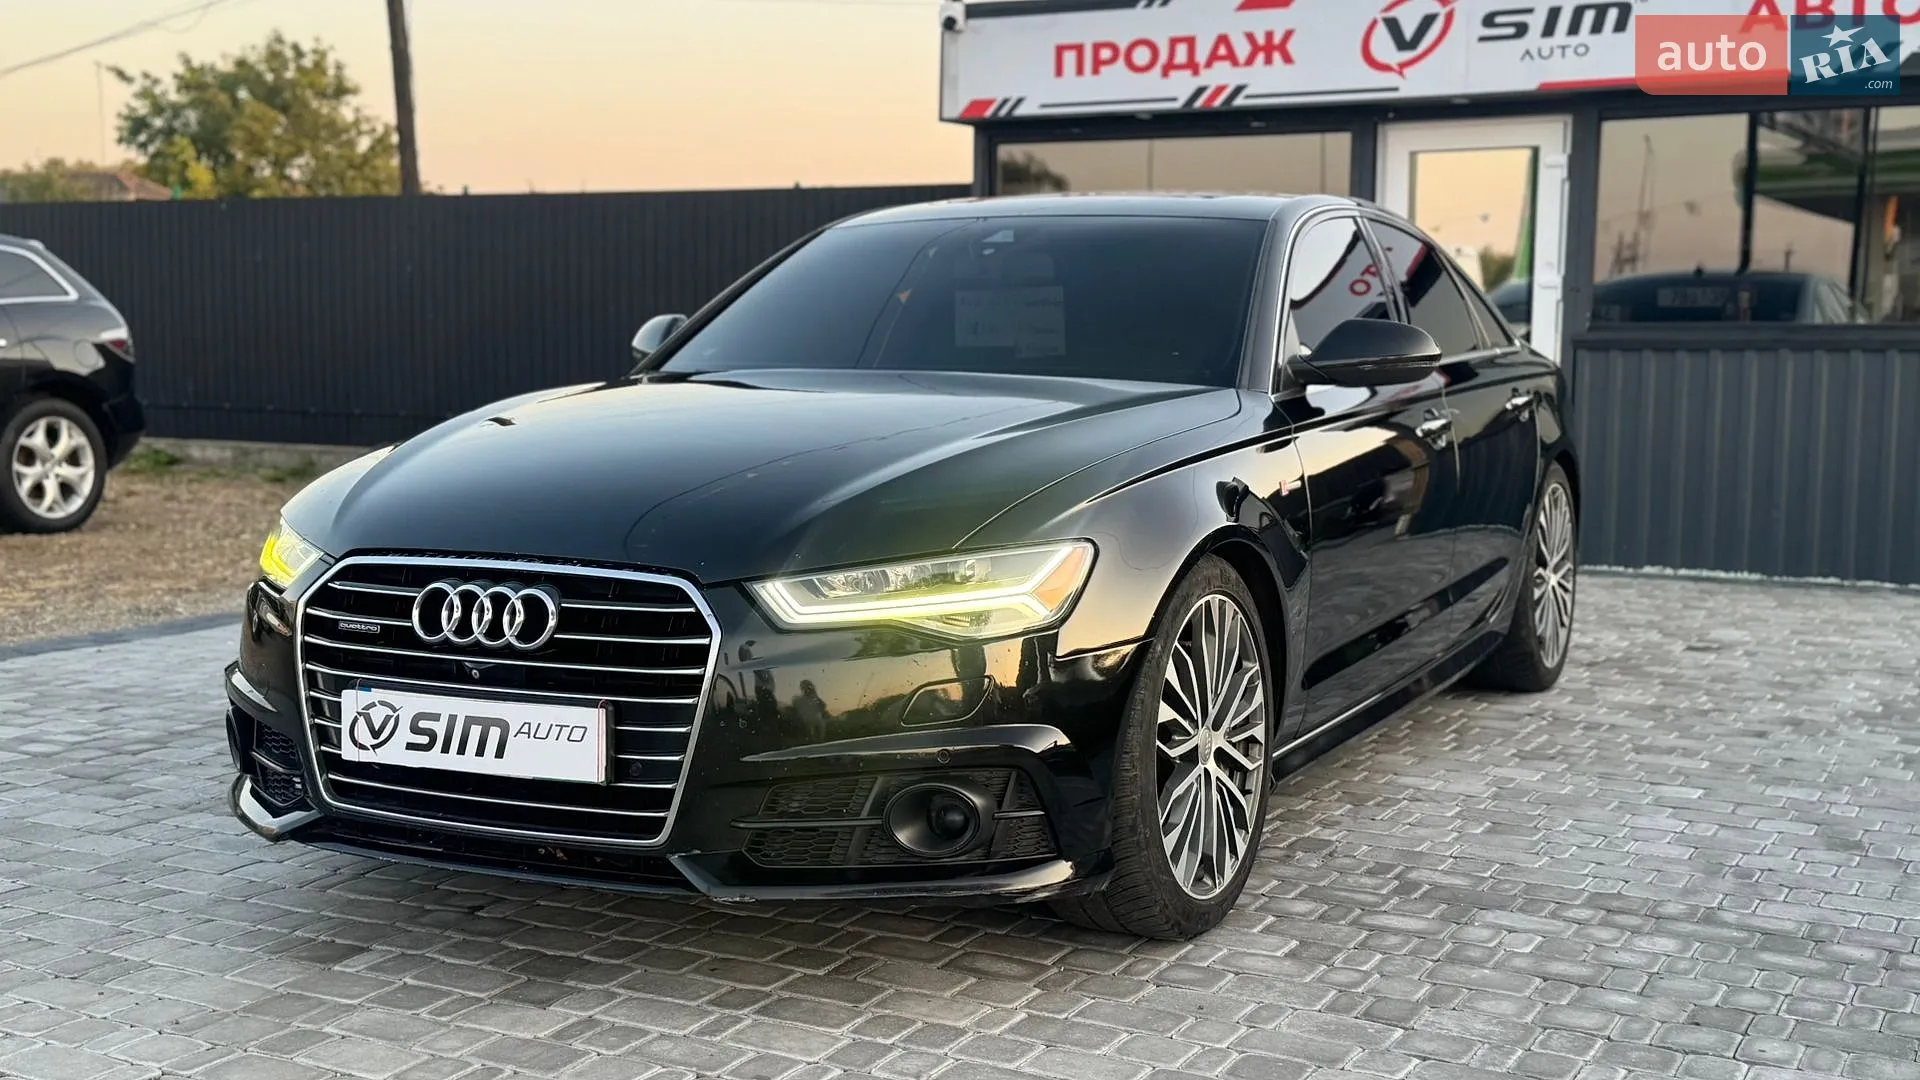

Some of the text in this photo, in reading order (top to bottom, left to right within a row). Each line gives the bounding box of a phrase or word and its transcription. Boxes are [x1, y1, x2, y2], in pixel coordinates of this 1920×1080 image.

[1476, 2, 1632, 43] SIM
[1053, 28, 1297, 80] ПРОДАЖ
[1519, 43, 1591, 62] AUTO
[339, 622, 378, 631] quattro
[405, 711, 511, 760] SIM
[513, 721, 588, 743] AUTO
